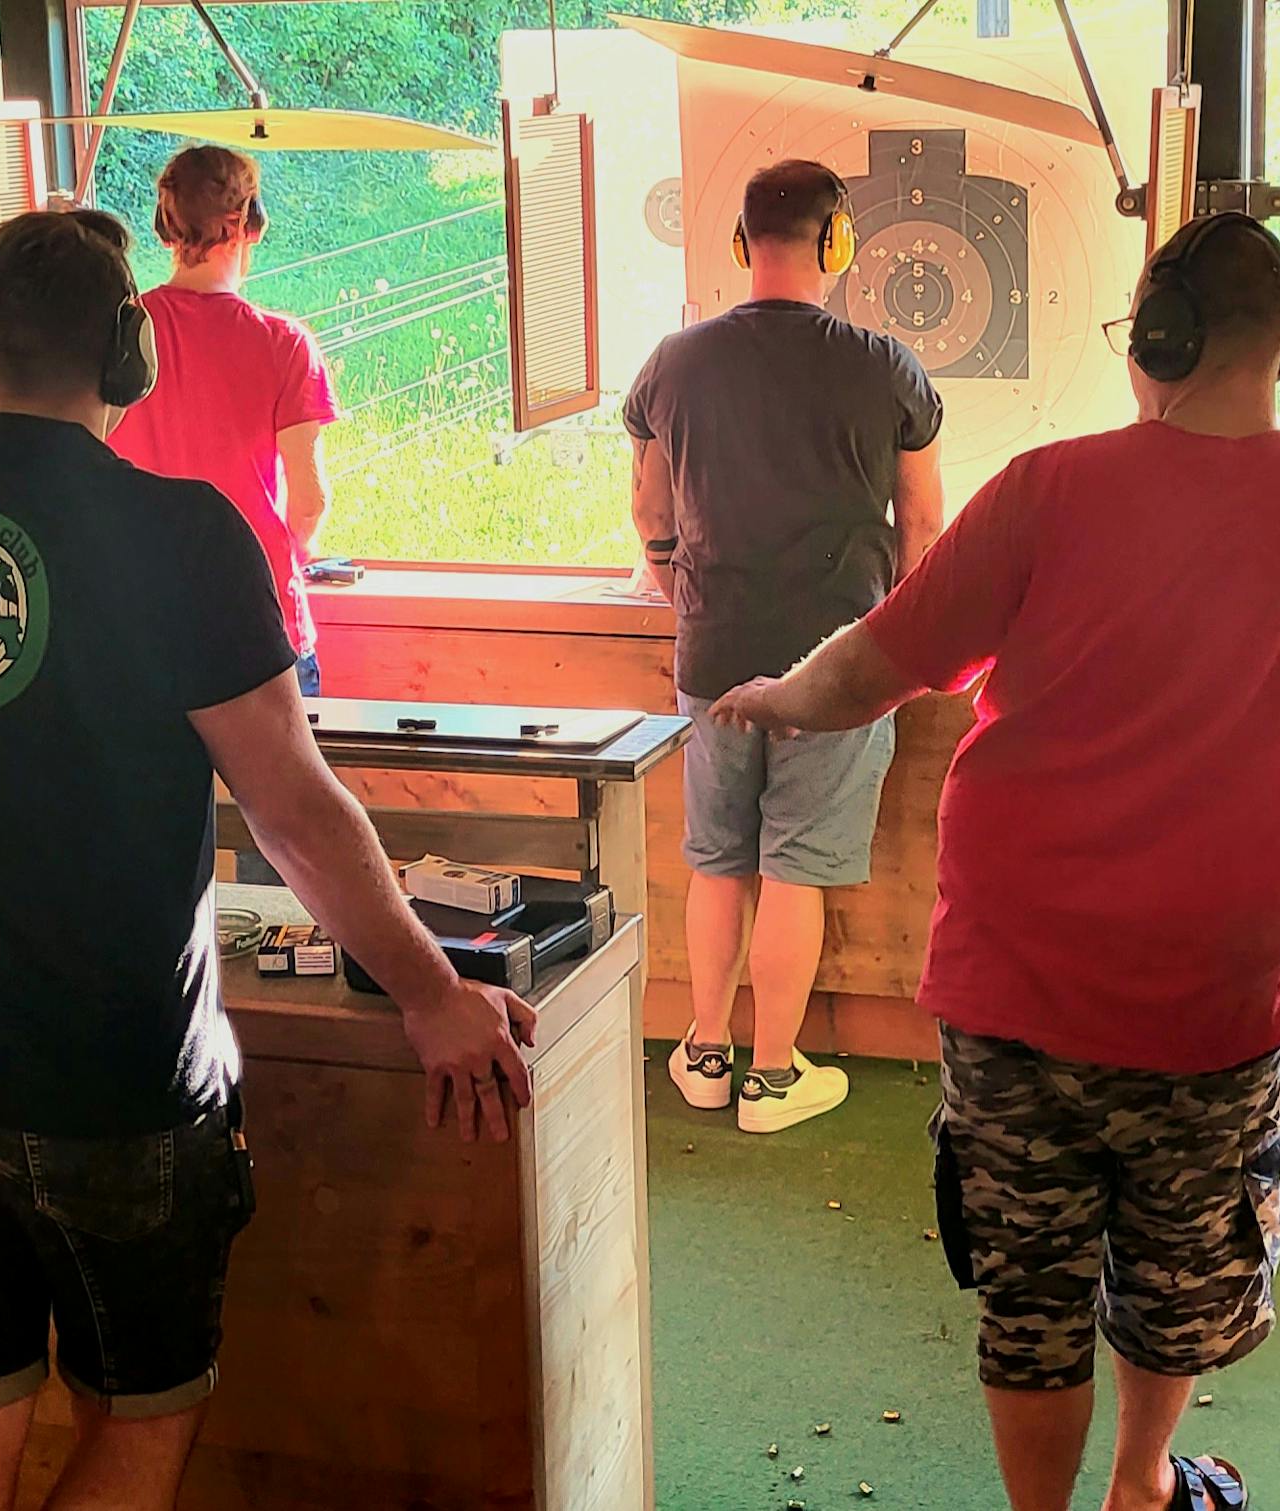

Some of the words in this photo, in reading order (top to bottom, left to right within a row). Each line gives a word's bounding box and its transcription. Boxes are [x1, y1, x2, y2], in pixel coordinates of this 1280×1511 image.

[911, 139, 923, 155] 3
[911, 189, 923, 205] 3
[912, 238, 924, 253] 4
[912, 262, 925, 278] 5
[864, 287, 877, 303] 4
[912, 284, 925, 293] 10
[960, 288, 973, 304] 4
[1009, 289, 1022, 305] 3
[1048, 290, 1058, 304] 2
[912, 311, 925, 327] 5
[912, 337, 925, 353] 4
